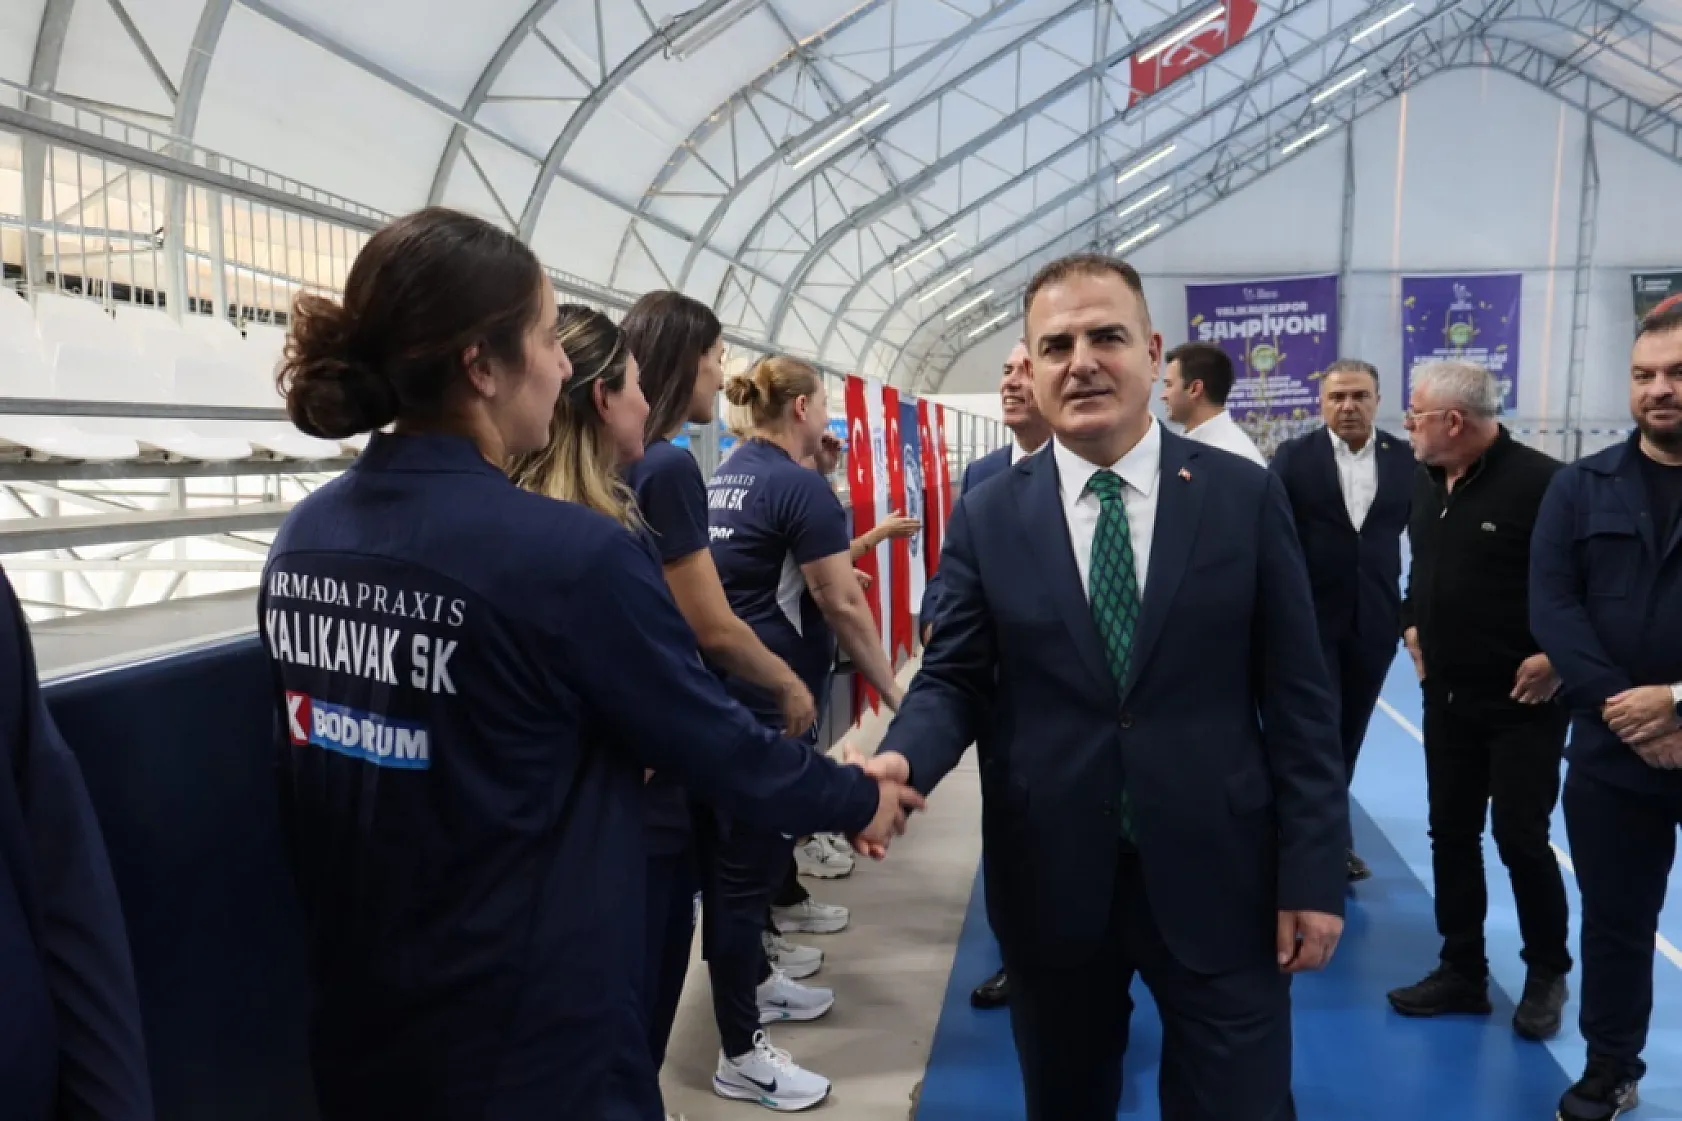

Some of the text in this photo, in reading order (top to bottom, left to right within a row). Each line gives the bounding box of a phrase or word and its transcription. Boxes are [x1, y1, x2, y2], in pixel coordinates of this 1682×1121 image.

[728, 488, 749, 511] SK
[355, 582, 467, 627] PRAXIS
[265, 607, 458, 694] YALIKAVAK SK
[312, 704, 429, 760] BODRUM
